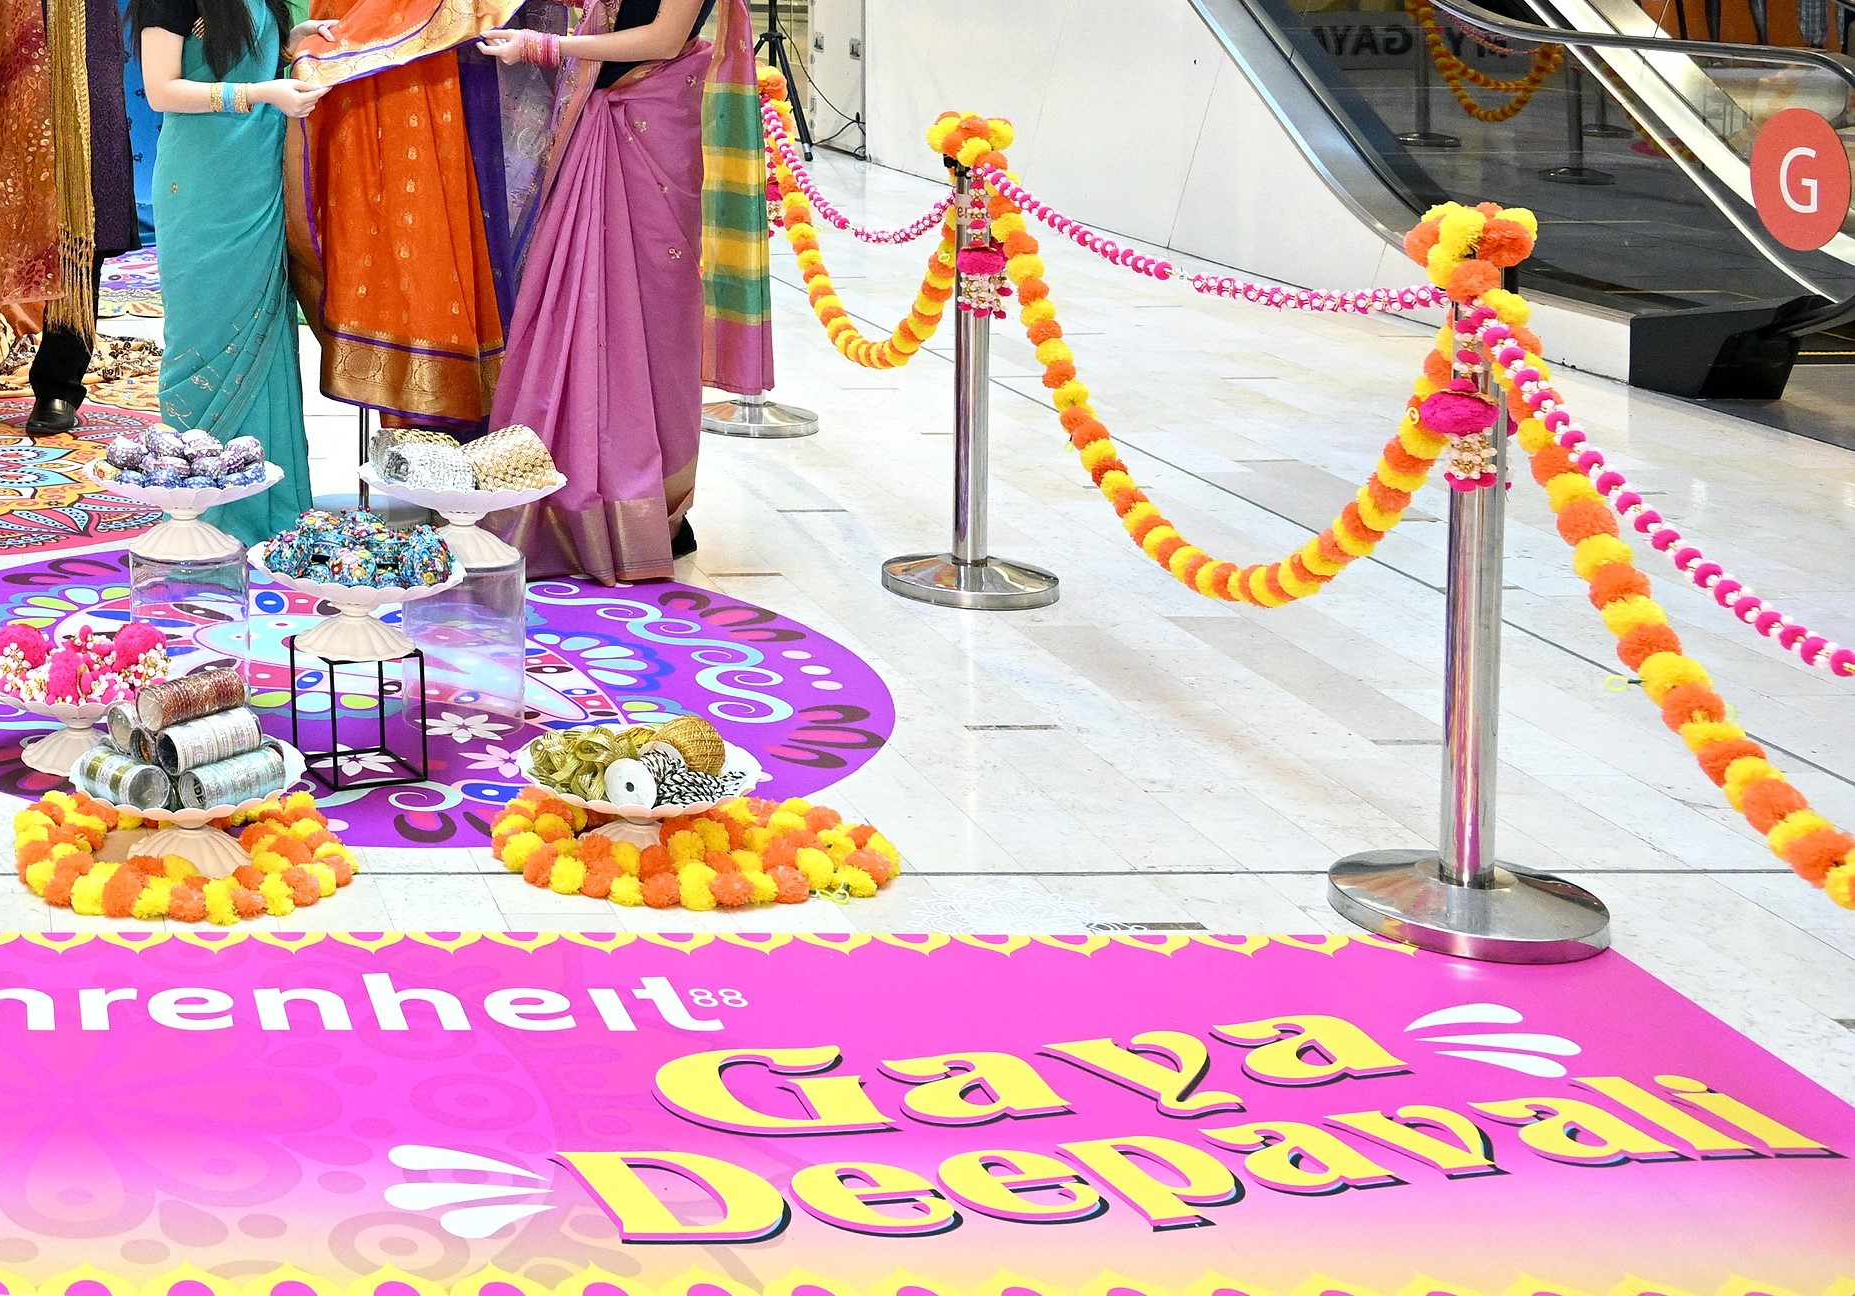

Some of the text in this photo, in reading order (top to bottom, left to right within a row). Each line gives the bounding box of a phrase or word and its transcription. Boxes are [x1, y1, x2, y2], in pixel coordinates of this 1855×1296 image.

[1779, 147, 1819, 214] G
[688, 988, 749, 1009] 88
[652, 1014, 1416, 1137] Gaya
[548, 1074, 1848, 1245] Deepavali
